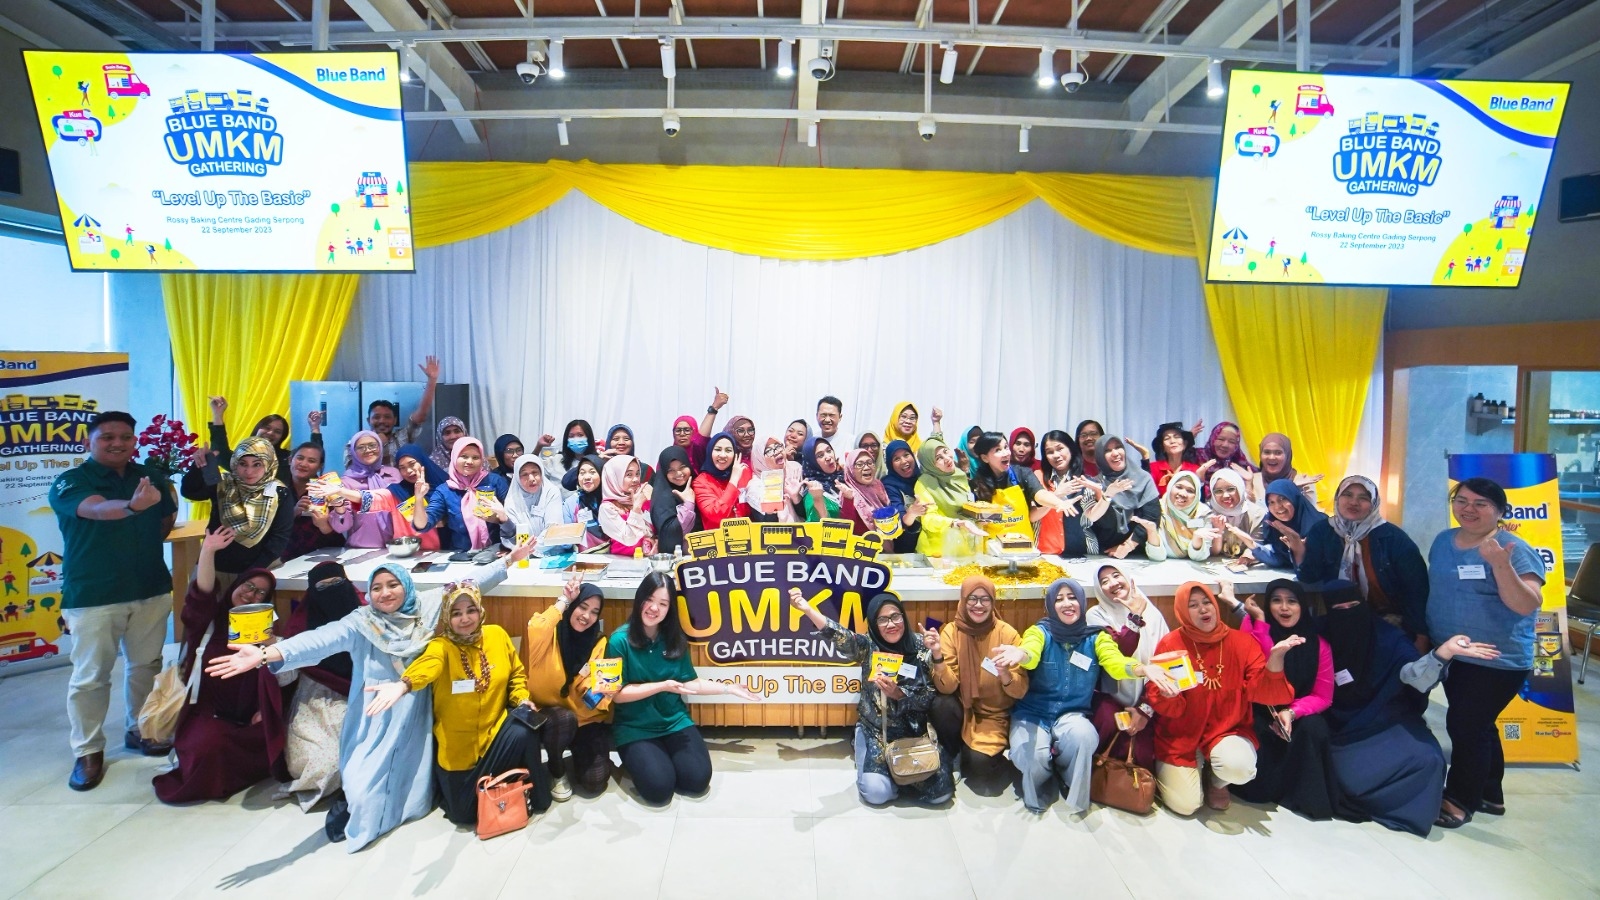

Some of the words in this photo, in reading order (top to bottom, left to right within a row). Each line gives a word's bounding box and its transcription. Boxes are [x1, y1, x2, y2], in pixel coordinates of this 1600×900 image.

[316, 68, 347, 81] Blue
[350, 67, 385, 81] Band
[1489, 96, 1518, 110] Blue
[1520, 97, 1554, 111] Band
[168, 114, 218, 132] BLUE
[221, 114, 275, 132] BAND
[166, 130, 281, 163] UMKM
[1341, 135, 1387, 152] BLUE
[1391, 136, 1438, 155] BAND
[190, 161, 265, 175] GATHERING
[1335, 151, 1440, 184] UMKM
[1348, 180, 1417, 194] GATHERING
[203, 190, 227, 209] Up
[228, 190, 259, 206] The
[166, 216, 189, 224] Rossy
[191, 216, 216, 224] Baking
[218, 216, 243, 224] Centre
[245, 216, 271, 224] Gading
[273, 216, 304, 224] Serpong
[1352, 208, 1373, 225] Up
[1376, 208, 1401, 224] The
[1310, 231, 1331, 239] Rossy
[1333, 232, 1356, 240] Baking
[1382, 233, 1406, 242] Gading
[1408, 235, 1436, 243] Serpong
[1350, 242, 1386, 250] September
[0, 411, 38, 423] LUE
[0, 422, 88, 445] MK
[0, 444, 85, 456] GATHERING
[15, 460, 38, 472] Up
[40, 458, 70, 469] The
[18, 480, 53, 488] Septemb
[1502, 503, 1547, 520] Band
[682, 561, 776, 589] BLUE
[787, 561, 885, 589] BAND
[713, 638, 848, 659] GATHERIN
[747, 675, 779, 698] Up
[783, 675, 827, 694] The
